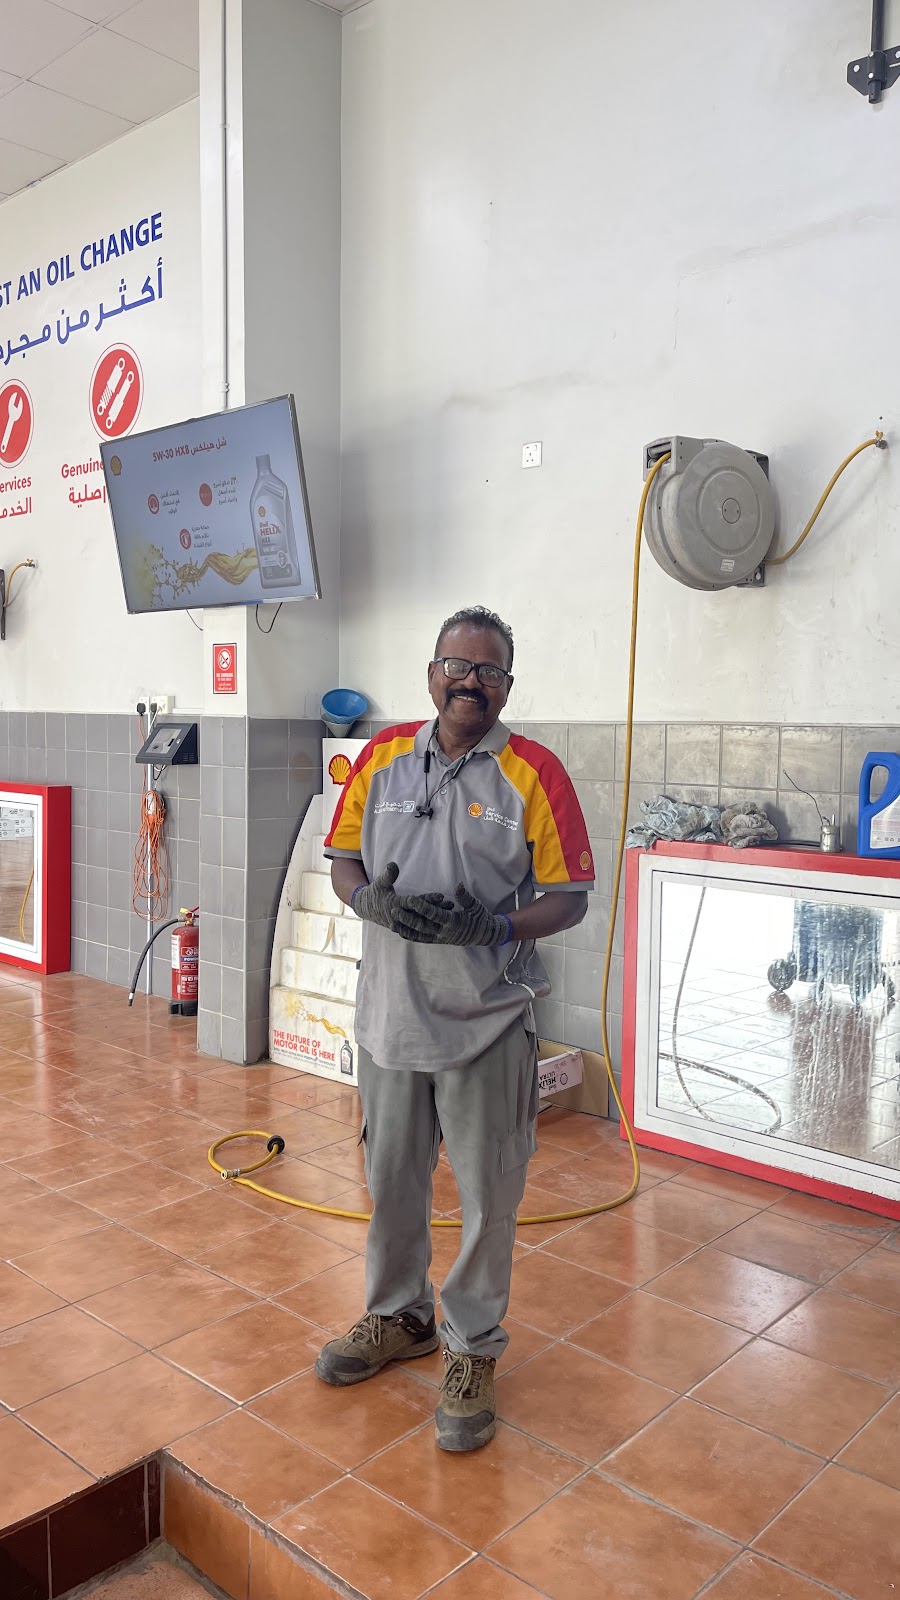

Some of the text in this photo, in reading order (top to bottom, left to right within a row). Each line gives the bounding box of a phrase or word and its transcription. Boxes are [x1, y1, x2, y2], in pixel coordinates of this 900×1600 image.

[17, 268, 40, 300] AN
[46, 254, 75, 286] OIL
[80, 212, 162, 270] CHANGE
[95, 257, 162, 332] أكثر
[57, 309, 90, 344] من
[152, 449, 174, 462] 5W-30
[175, 445, 190, 456] HX8
[260, 526, 280, 536] HELIX
[485, 810, 503, 820] Service
[274, 1030, 320, 1048] THE FUTURE OF
[274, 1038, 298, 1050] MOTOR
[300, 1046, 310, 1054] OIL
[312, 1048, 318, 1056] IS
[319, 1050, 335, 1061] HERE
[540, 1071, 556, 1080] ULTRA
[539, 1077, 556, 1089] HELIX
